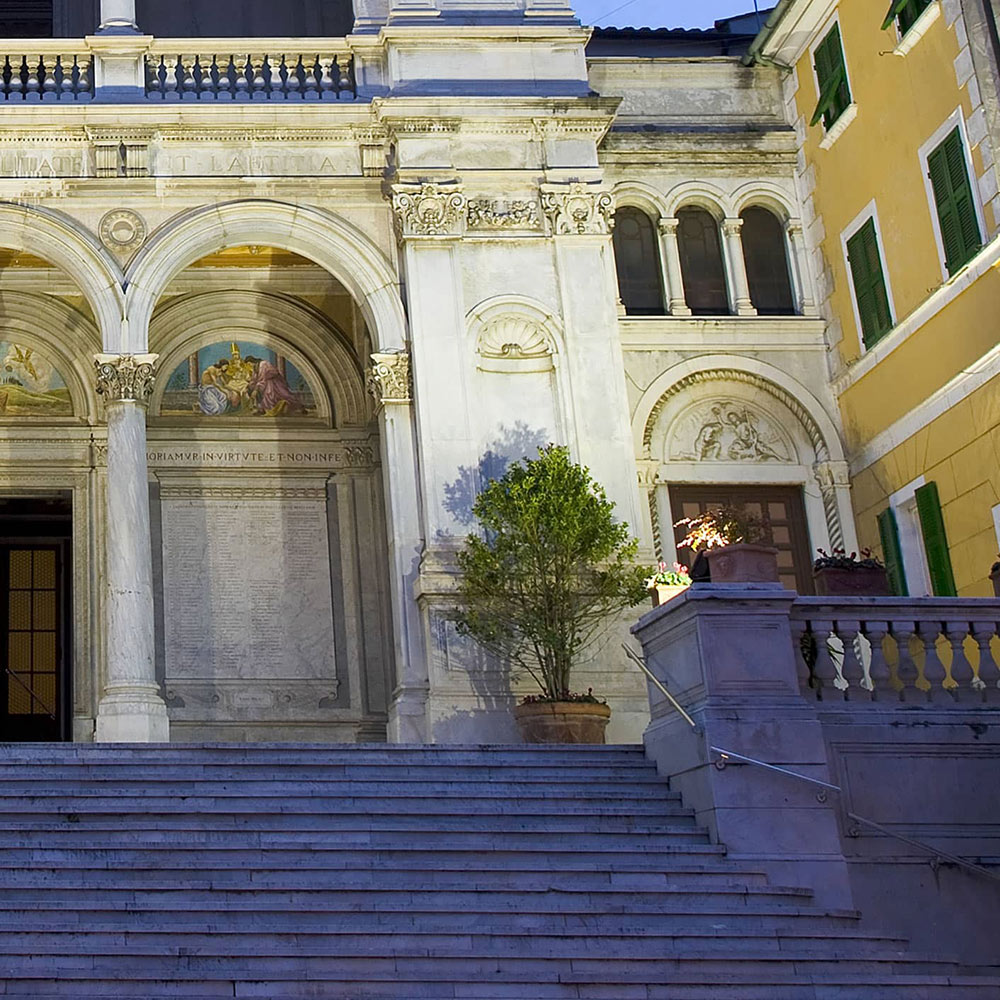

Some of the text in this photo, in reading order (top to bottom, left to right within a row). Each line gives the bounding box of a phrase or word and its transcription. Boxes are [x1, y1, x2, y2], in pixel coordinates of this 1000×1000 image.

[145, 452, 199, 461] ORIAMVR
[203, 452, 214, 461] IN
[216, 452, 265, 462] VIRTVTE
[269, 452, 284, 462] ET
[287, 452, 312, 462] NON
